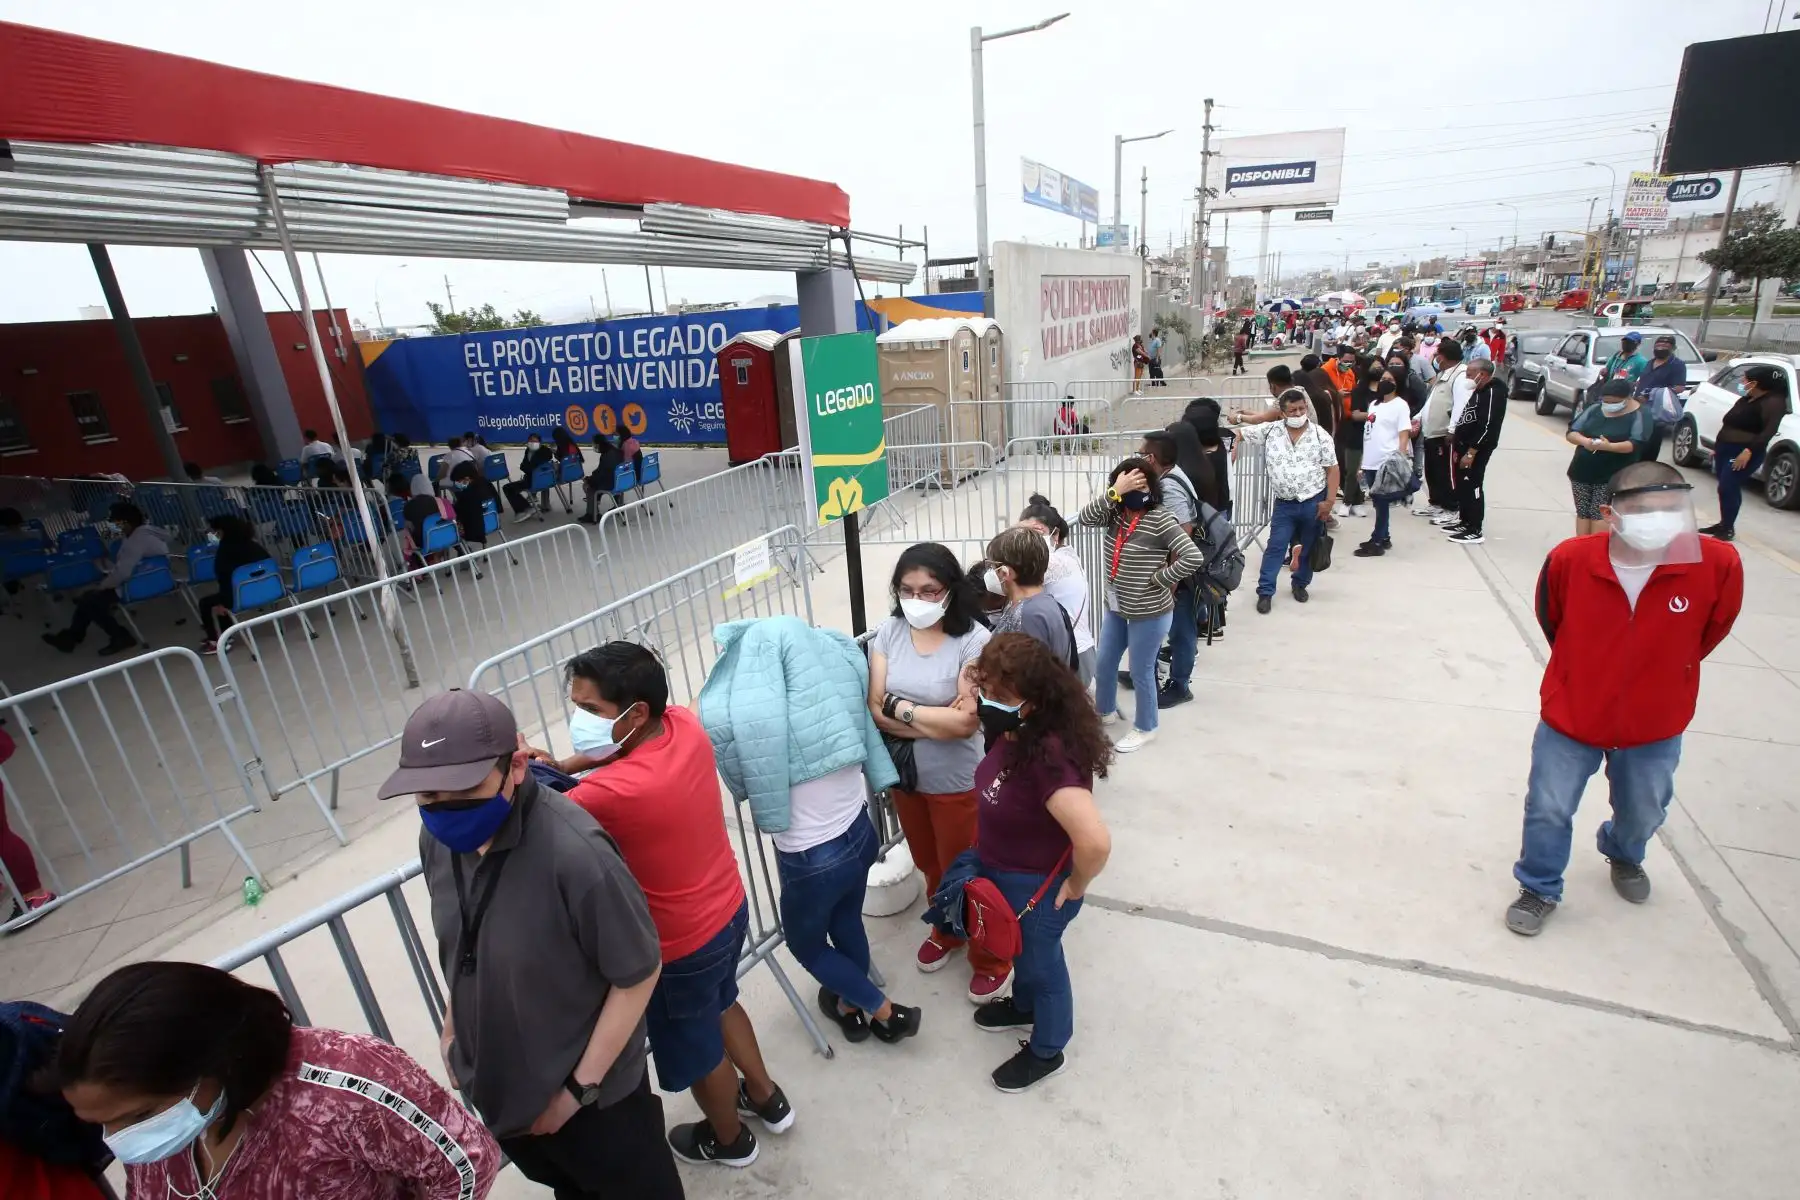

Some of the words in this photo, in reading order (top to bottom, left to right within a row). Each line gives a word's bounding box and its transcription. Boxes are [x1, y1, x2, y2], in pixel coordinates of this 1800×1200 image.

[1230, 167, 1311, 183] DISPONIBLE
[1673, 183, 1700, 195] JMT
[1041, 279, 1129, 322] POLIDEPORTIVO
[464, 342, 490, 368] EL
[493, 331, 611, 367] PROYECTO
[618, 322, 727, 359] LEGADO
[1041, 322, 1075, 360] VILLA
[1076, 320, 1088, 351] EL
[1089, 311, 1129, 346] SALVADOR
[469, 370, 496, 396] TE
[500, 368, 532, 396] DA
[534, 366, 563, 394] LA
[567, 357, 720, 393] BIENVENIDA
[477, 413, 562, 431] @LegadoOficialPE
